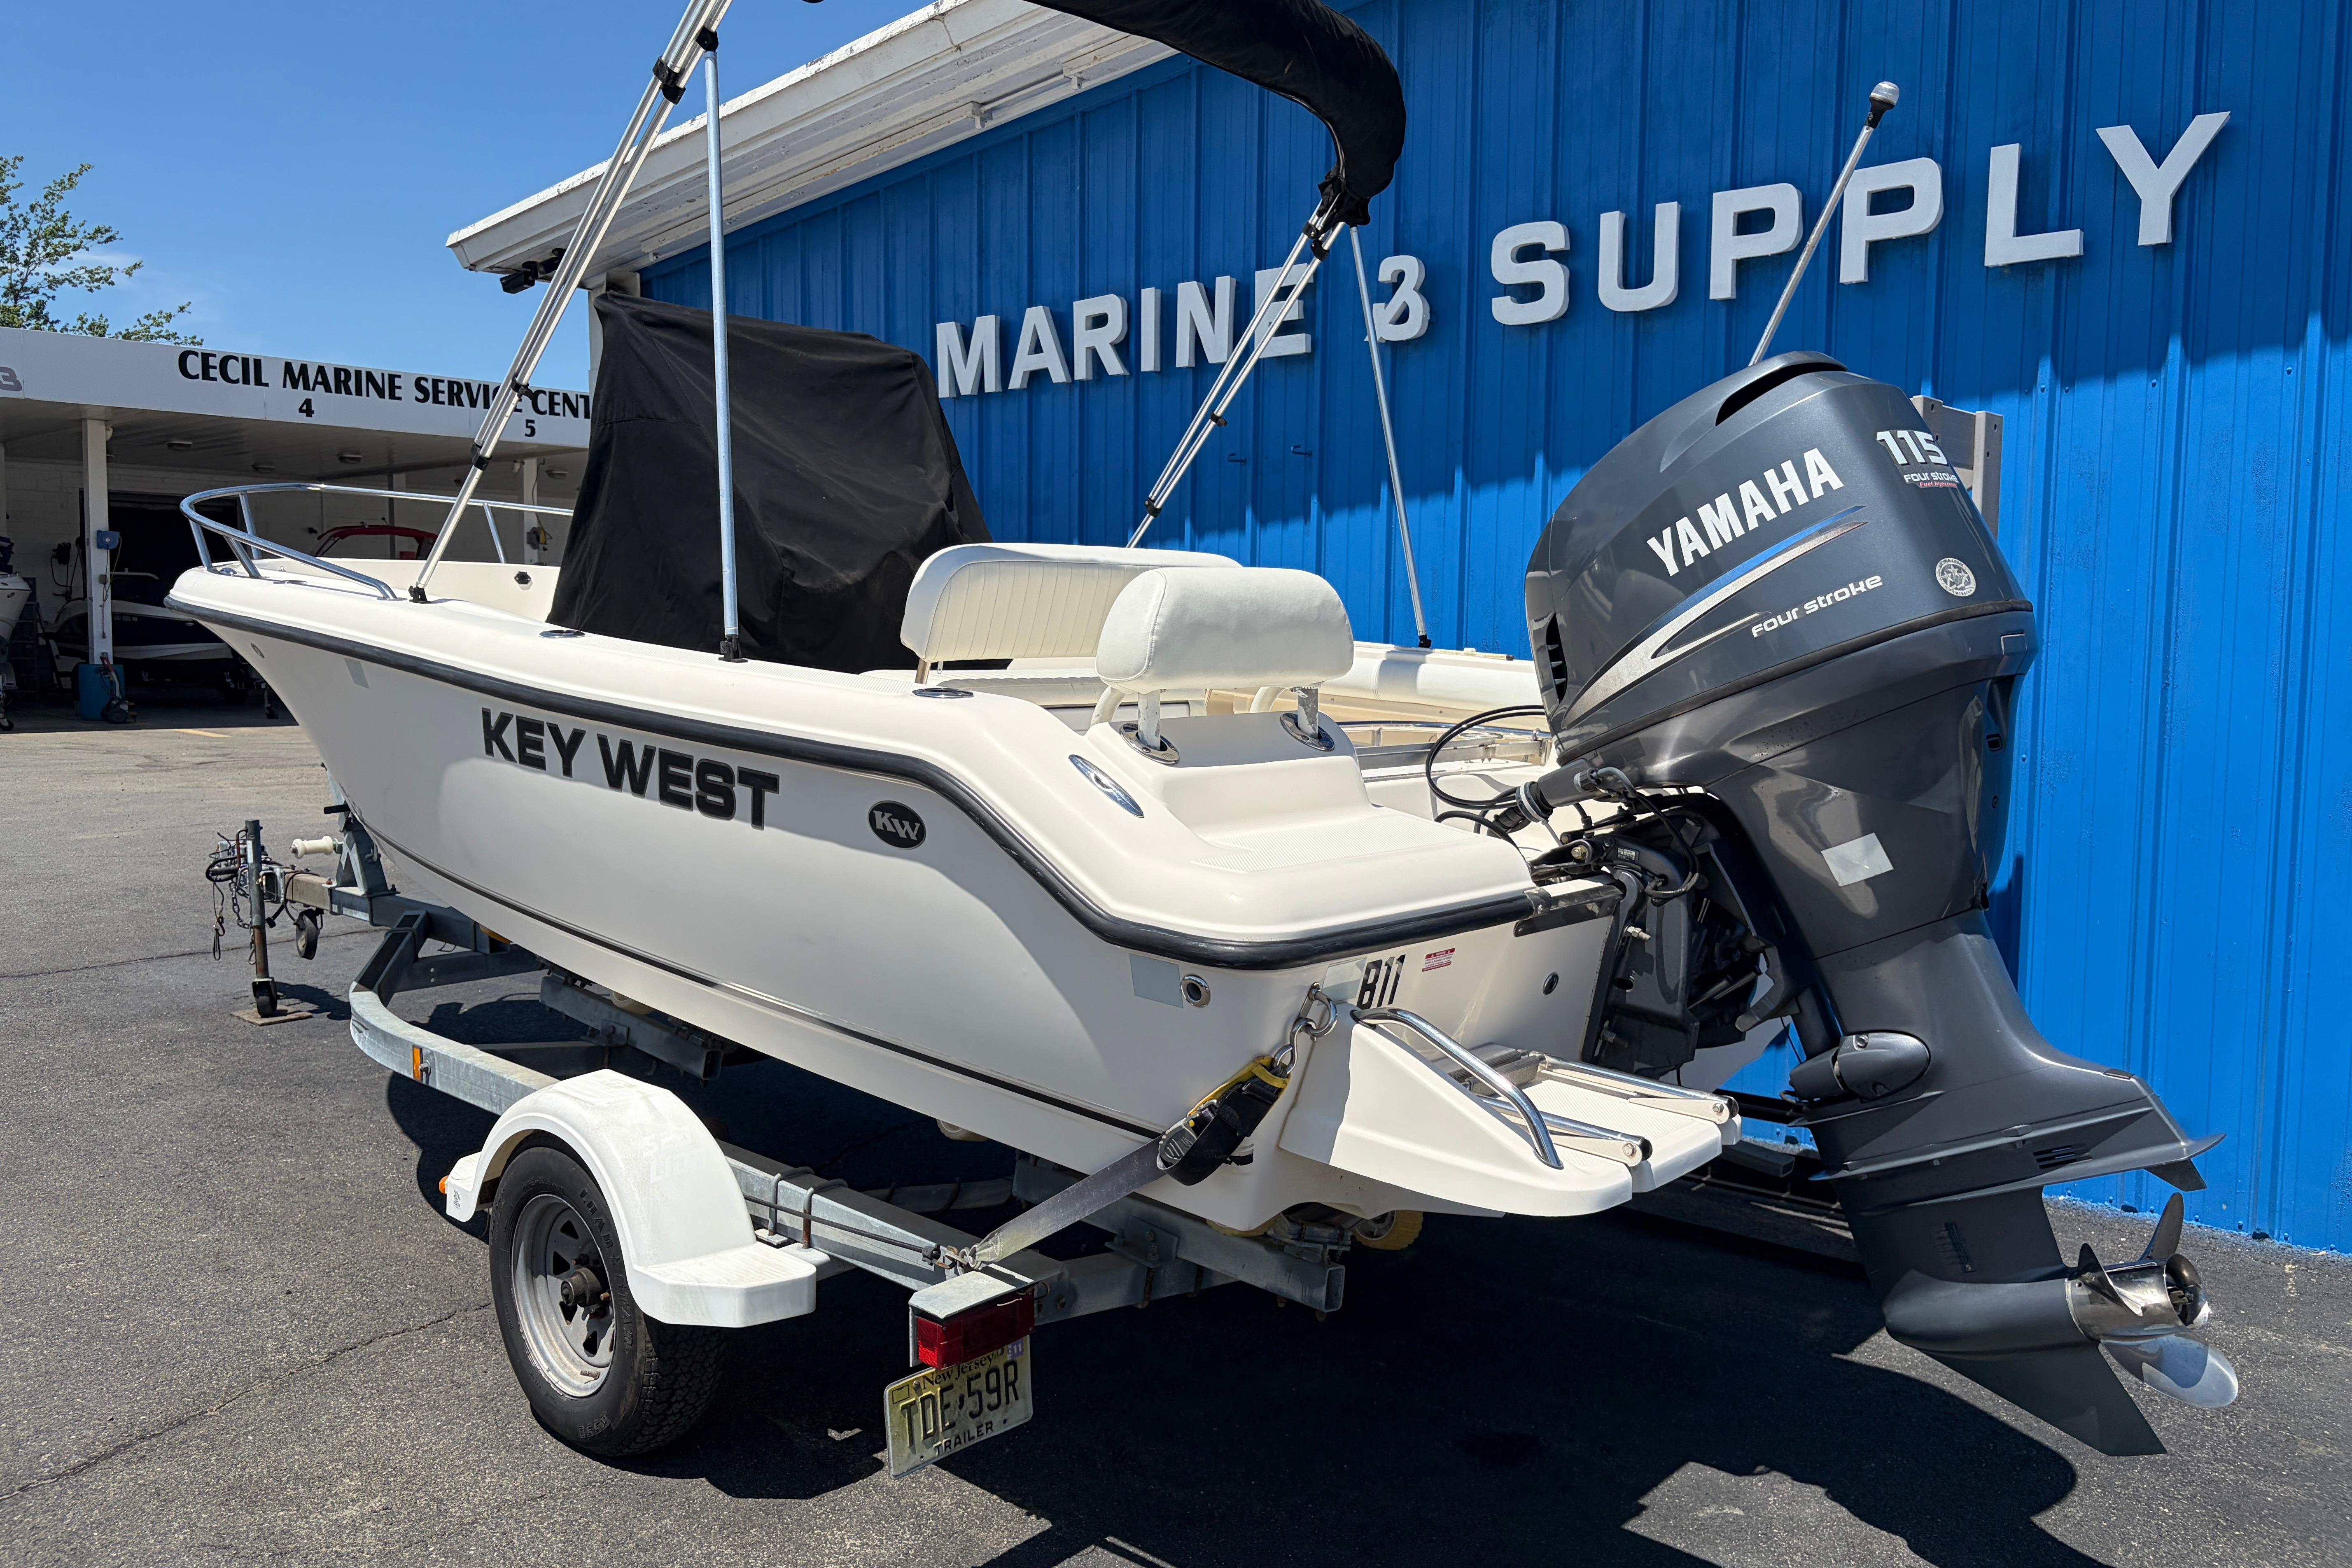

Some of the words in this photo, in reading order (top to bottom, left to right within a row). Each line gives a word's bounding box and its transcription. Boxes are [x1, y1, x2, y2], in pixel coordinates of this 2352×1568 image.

[936, 263, 1314, 398] MARINE
[1364, 254, 1430, 342] &
[1491, 111, 2231, 325] SUPPLY
[178, 350, 269, 387] CECIL
[282, 361, 402, 401] MARINE
[414, 376, 523, 413] SERVI
[298, 398, 314, 417] 4
[525, 419, 536, 437] 5
[1877, 430, 1948, 465] 115
[1647, 448, 1844, 576] YAMAHA
[482, 707, 586, 779] KEY
[597, 733, 779, 831] WEST
[873, 810, 920, 840] KW
[579, 1189, 614, 1248] LOAD
[1014, 1343, 1022, 1354] 11
[923, 1370, 954, 1389] New
[955, 1352, 994, 1380] Jersey
[933, 1421, 993, 1456] TRAILER
